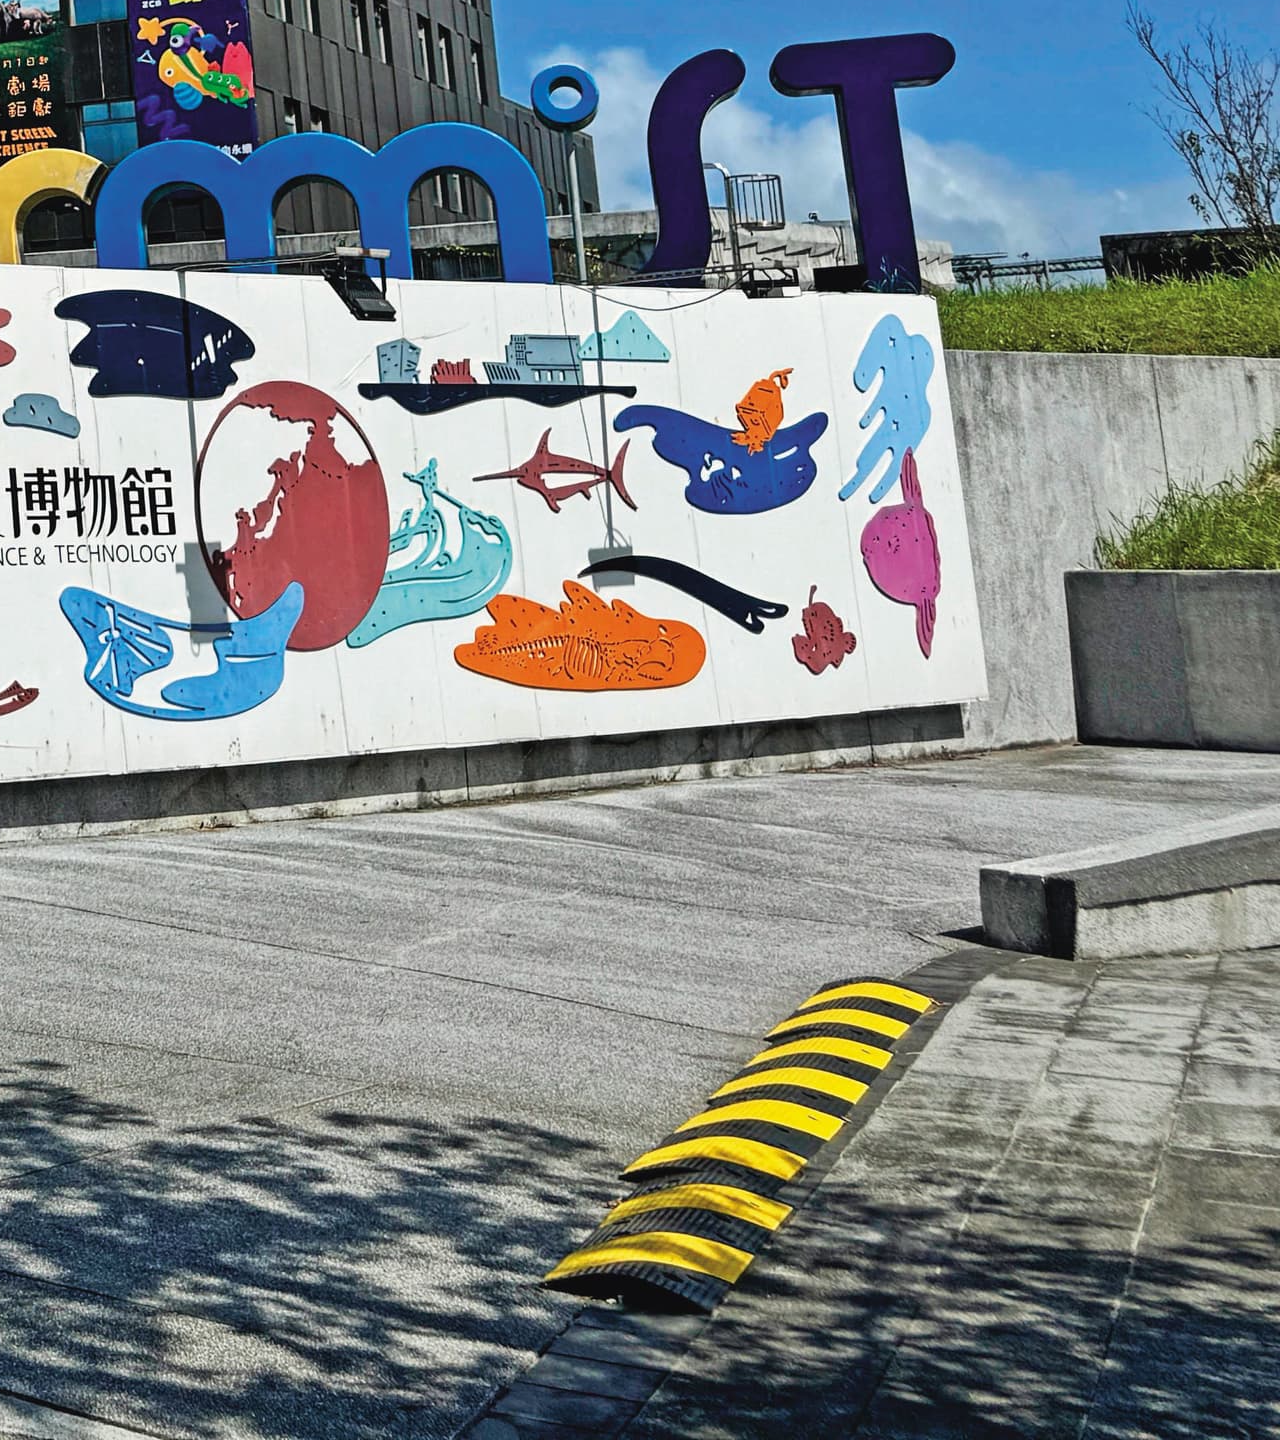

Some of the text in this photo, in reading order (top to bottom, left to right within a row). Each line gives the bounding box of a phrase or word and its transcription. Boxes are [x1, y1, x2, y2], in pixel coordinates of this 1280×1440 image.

[10, 126, 58, 142] SCREEN
[33, 546, 46, 565] &
[54, 543, 178, 564] TECHNOLOGY
